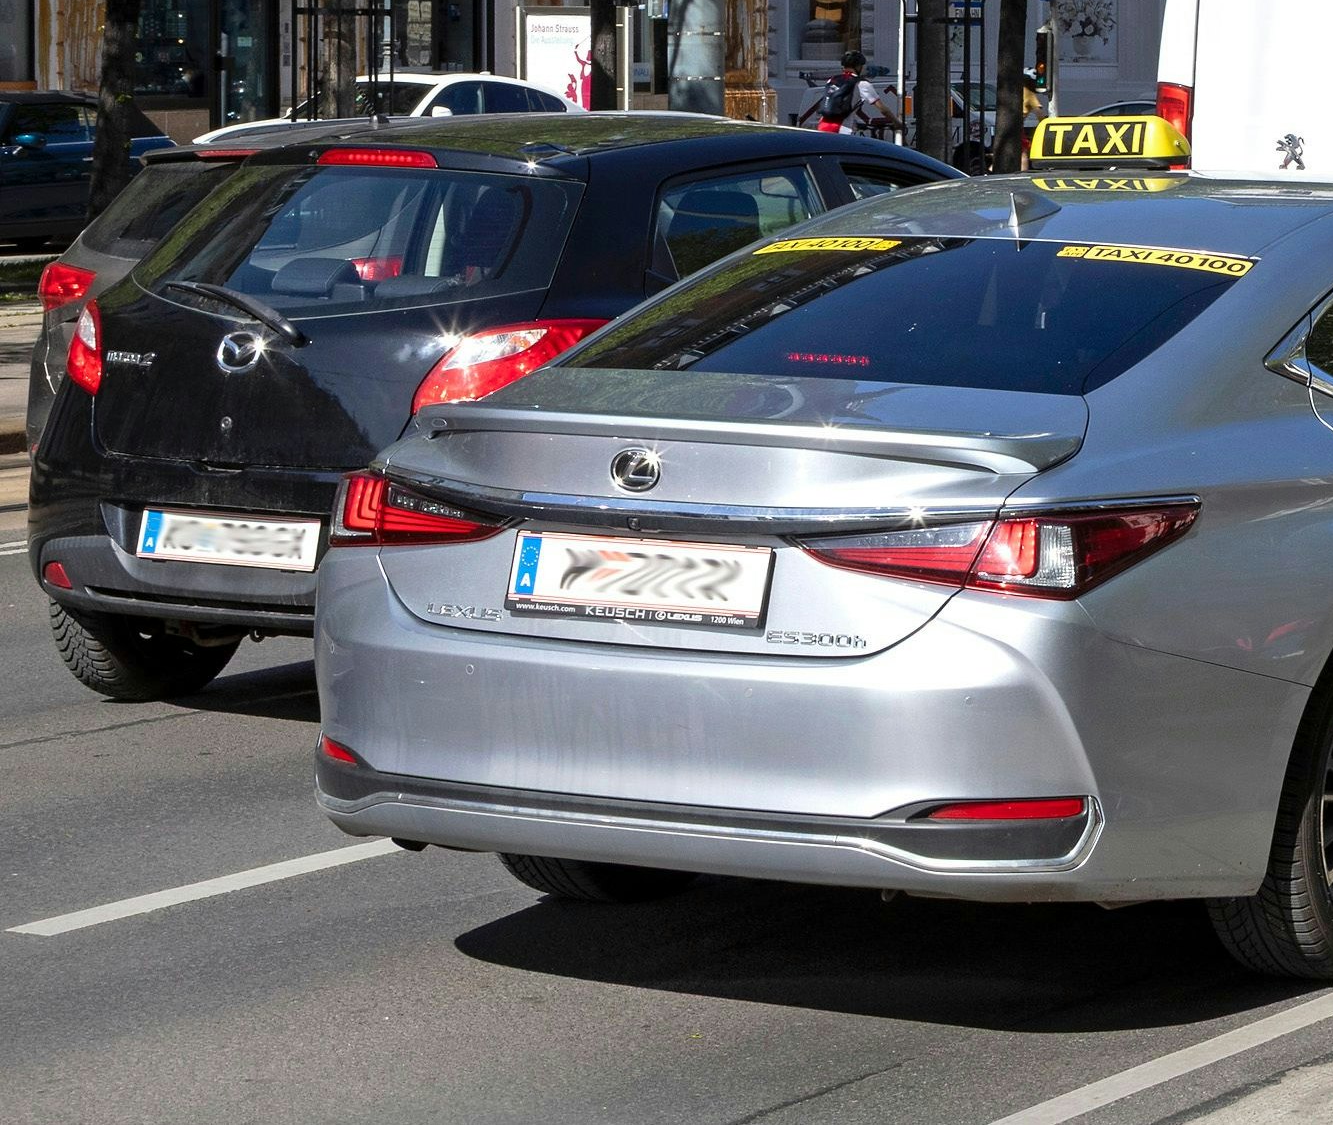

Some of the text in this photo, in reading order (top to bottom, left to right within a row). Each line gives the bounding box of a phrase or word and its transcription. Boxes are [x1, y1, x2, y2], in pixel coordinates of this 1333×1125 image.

[531, 24, 580, 33] Johann Strauss
[1049, 123, 1143, 154] TAXI
[1095, 248, 1152, 261] TAXI
[145, 537, 153, 548] A
[520, 573, 531, 587] A
[427, 602, 502, 622] LEXUS
[515, 601, 576, 613] www.keusch.com
[585, 605, 744, 626] KEUSCH LEXUS 1200 Wien
[766, 629, 868, 649] ES300h
